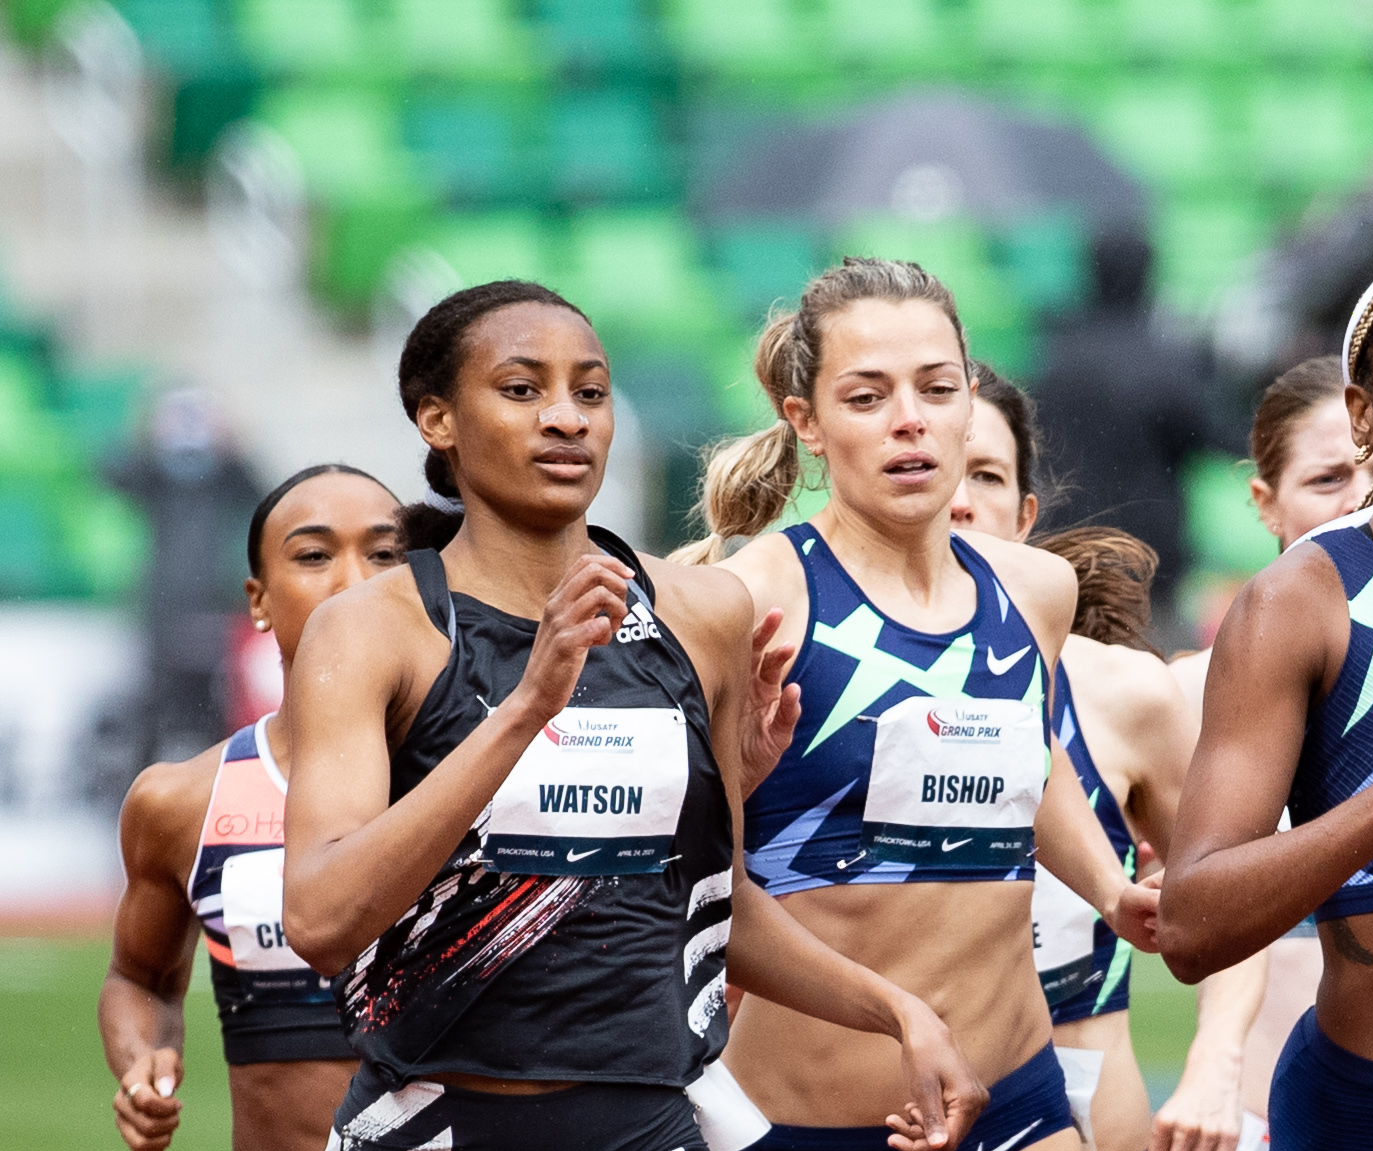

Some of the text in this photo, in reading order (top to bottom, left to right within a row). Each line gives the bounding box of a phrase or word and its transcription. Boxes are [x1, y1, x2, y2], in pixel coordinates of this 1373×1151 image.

[941, 726, 1001, 738] GRAND PRIX
[561, 735, 634, 747] GRAND PRIX
[921, 774, 1005, 804] BISHOP
[539, 784, 643, 814] WATSON
[497, 848, 539, 857] TRACKTOWN,
